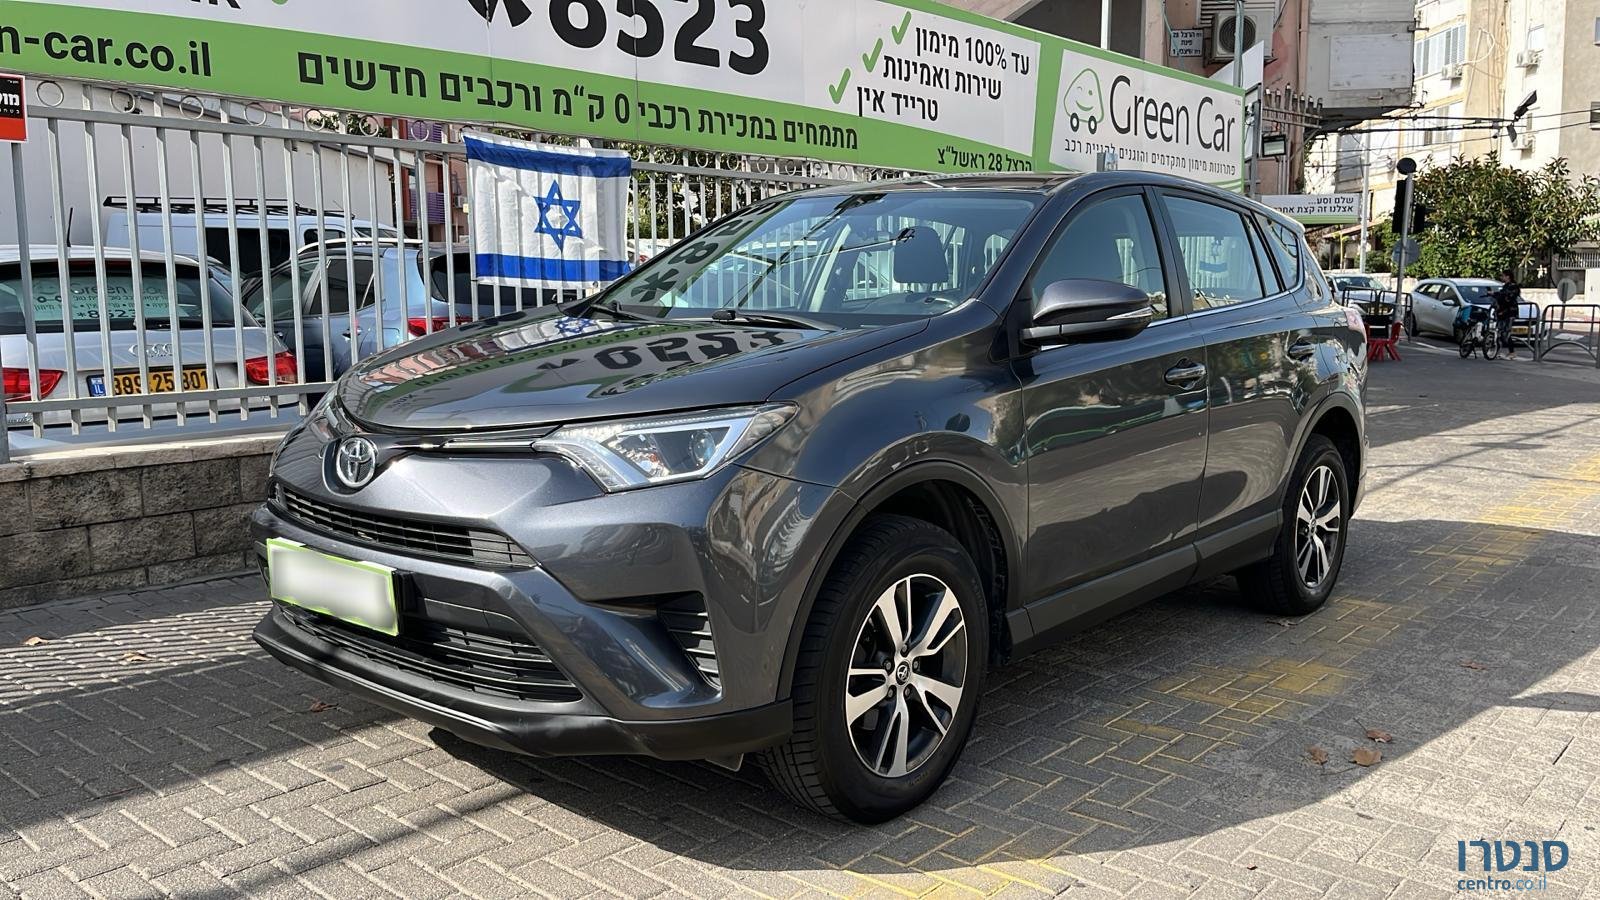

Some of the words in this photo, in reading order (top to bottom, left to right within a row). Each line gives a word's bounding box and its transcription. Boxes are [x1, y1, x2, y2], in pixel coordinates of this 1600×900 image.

[0, 25, 212, 77] n-car.co.il
[915, 27, 959, 58] מימון
[965, 37, 1007, 70] 100%
[298, 51, 427, 98] חדשים
[883, 55, 950, 90] ואמינות
[1011, 52, 1030, 75] עד
[439, 72, 542, 112] ורכבים
[954, 71, 1002, 100] שירות
[615, 93, 630, 124] 0
[857, 86, 885, 117] אין
[891, 92, 938, 121] טרייד
[1109, 75, 1189, 146] Green
[1197, 96, 1235, 153] Car
[638, 102, 691, 131] רכבי
[698, 109, 777, 141] במכירת
[784, 120, 858, 149] מתמחים
[1064, 138, 1082, 153] רכב
[988, 152, 1003, 171] 28
[1005, 154, 1032, 171] הרצל
[1151, 152, 1186, 170] מתקדמים
[1188, 158, 1207, 173] מימון
[1209, 162, 1236, 175] פתרונות
[1297, 206, 1315, 214] קצת
[1317, 205, 1327, 213] זה
[1334, 196, 1354, 204] שלם
